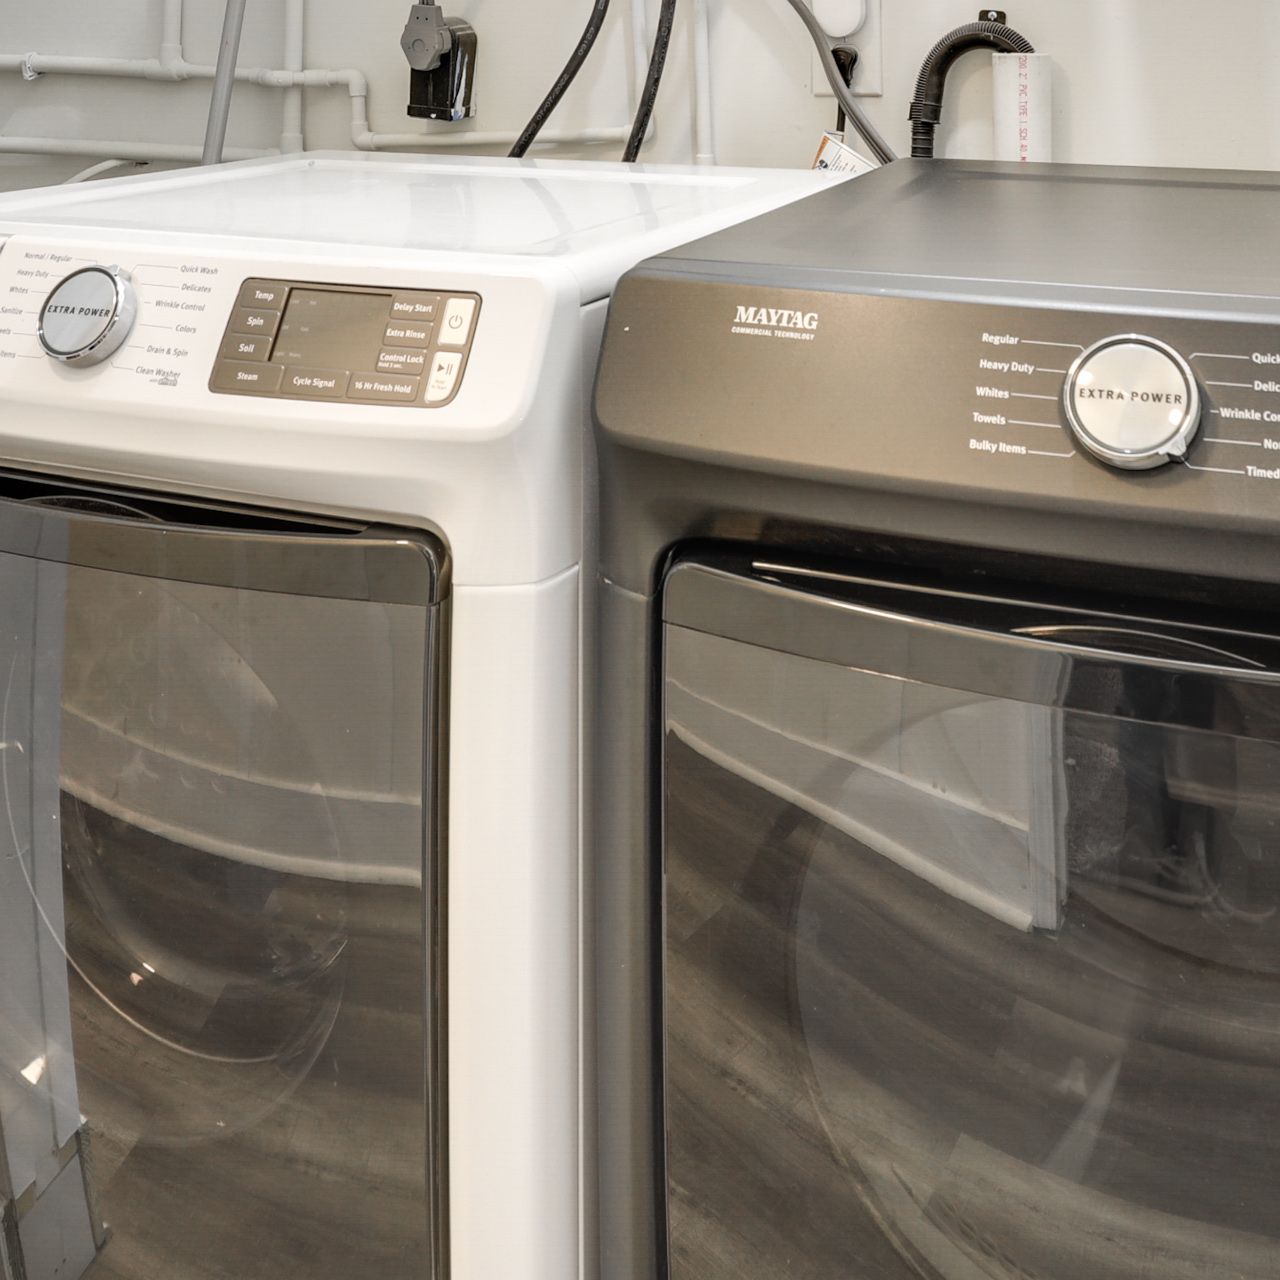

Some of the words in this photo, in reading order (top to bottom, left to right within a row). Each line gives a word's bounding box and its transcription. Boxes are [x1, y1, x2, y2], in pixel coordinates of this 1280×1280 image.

[1019, 101, 1028, 117] TYPE
[24, 252, 46, 261] Normal
[50, 254, 73, 263] Regular
[17, 269, 34, 279] Heavy
[35, 270, 49, 279] Duty
[180, 264, 199, 274] Quick
[200, 266, 218, 275] Wash
[9, 286, 29, 295] Whites
[181, 283, 212, 293] Delicates
[255, 291, 274, 301] Temp
[0, 306, 23, 315] Sanitize
[47, 305, 76, 314] EXTRA
[78, 307, 111, 317] POWER
[155, 300, 180, 309] Wrinkle
[180, 302, 205, 312] Control
[393, 302, 414, 313] Delay
[414, 303, 433, 313] Start
[246, 316, 264, 327] Spin
[734, 305, 819, 330] MAYTAG
[175, 324, 196, 334] Colors
[386, 328, 404, 337] Extra
[405, 329, 425, 339] Rinse
[731, 326, 772, 337] COMMERCIAL
[774, 330, 816, 340] TECHNOLOGY
[982, 333, 1019, 345] Regular
[146, 345, 164, 354] Drain
[173, 348, 188, 357] Spin
[238, 343, 255, 353] Soil
[0, 350, 16, 359] Items
[379, 352, 406, 363] Control
[406, 354, 424, 364] Lock
[136, 366, 154, 375] Clean
[155, 369, 181, 378] Washer
[979, 359, 1009, 372] Heavy
[1011, 361, 1035, 374] Duty
[236, 371, 259, 381] Steam
[292, 376, 311, 386] Cycle
[312, 378, 336, 389] Signal
[355, 381, 362, 389] 16
[363, 382, 372, 390] Hr
[373, 382, 393, 392] Fresh
[394, 383, 412, 393] Hold
[975, 386, 1009, 399] Whites
[1079, 388, 1125, 400] EXTRA
[1130, 391, 1183, 404] POWER
[972, 412, 1006, 425] Towels
[1220, 407, 1262, 420] Wrinkle
[969, 439, 998, 453] Bulky
[998, 442, 1027, 455] Items
[1246, 465, 1280, 480] Timed
